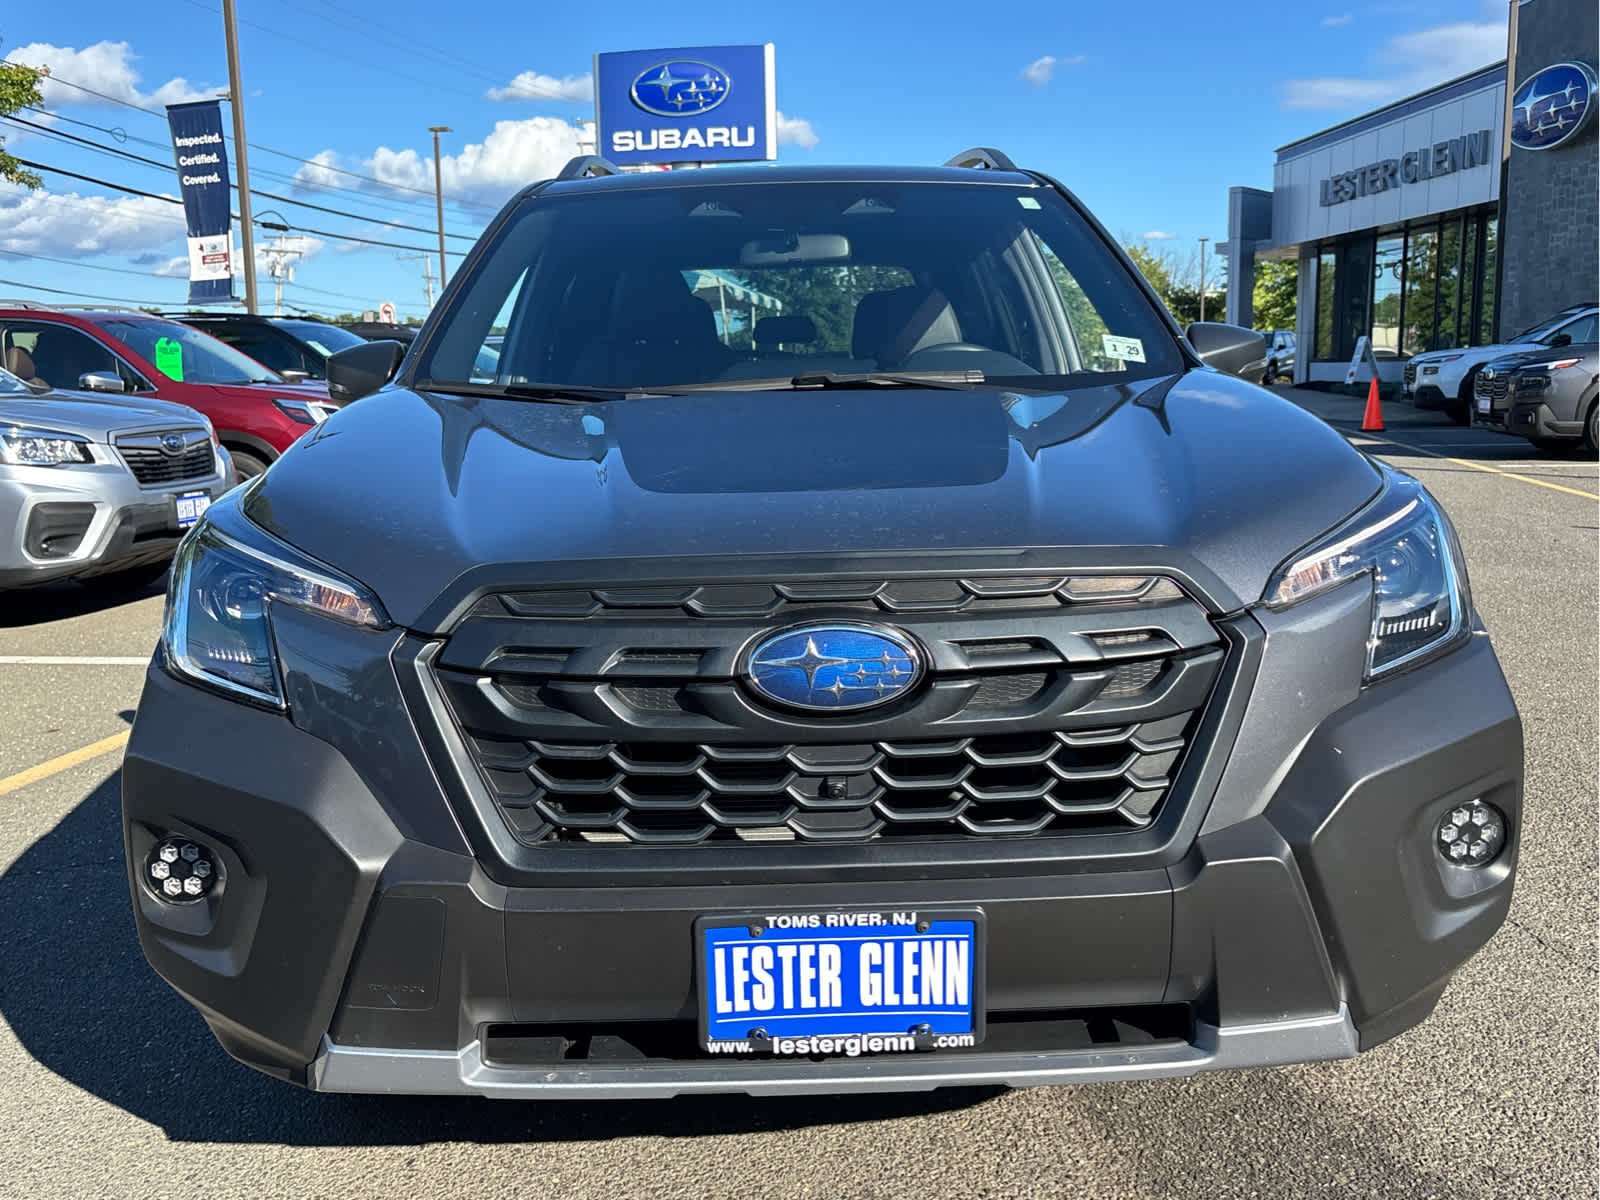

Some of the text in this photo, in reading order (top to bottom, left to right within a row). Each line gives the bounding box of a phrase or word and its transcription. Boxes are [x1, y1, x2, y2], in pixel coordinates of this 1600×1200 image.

[175, 132, 222, 147] Inspected.
[612, 126, 755, 152] SUBARU
[179, 152, 220, 166] Certified.
[1320, 130, 1491, 207] LESTER GLENN
[182, 171, 221, 186] Covered.
[1125, 345, 1140, 356] 29
[765, 912, 917, 929] TOMS RIVER, NJ
[713, 940, 969, 1014] LESTER GLENN
[706, 1035, 975, 1056] www. lesterglenn .com
